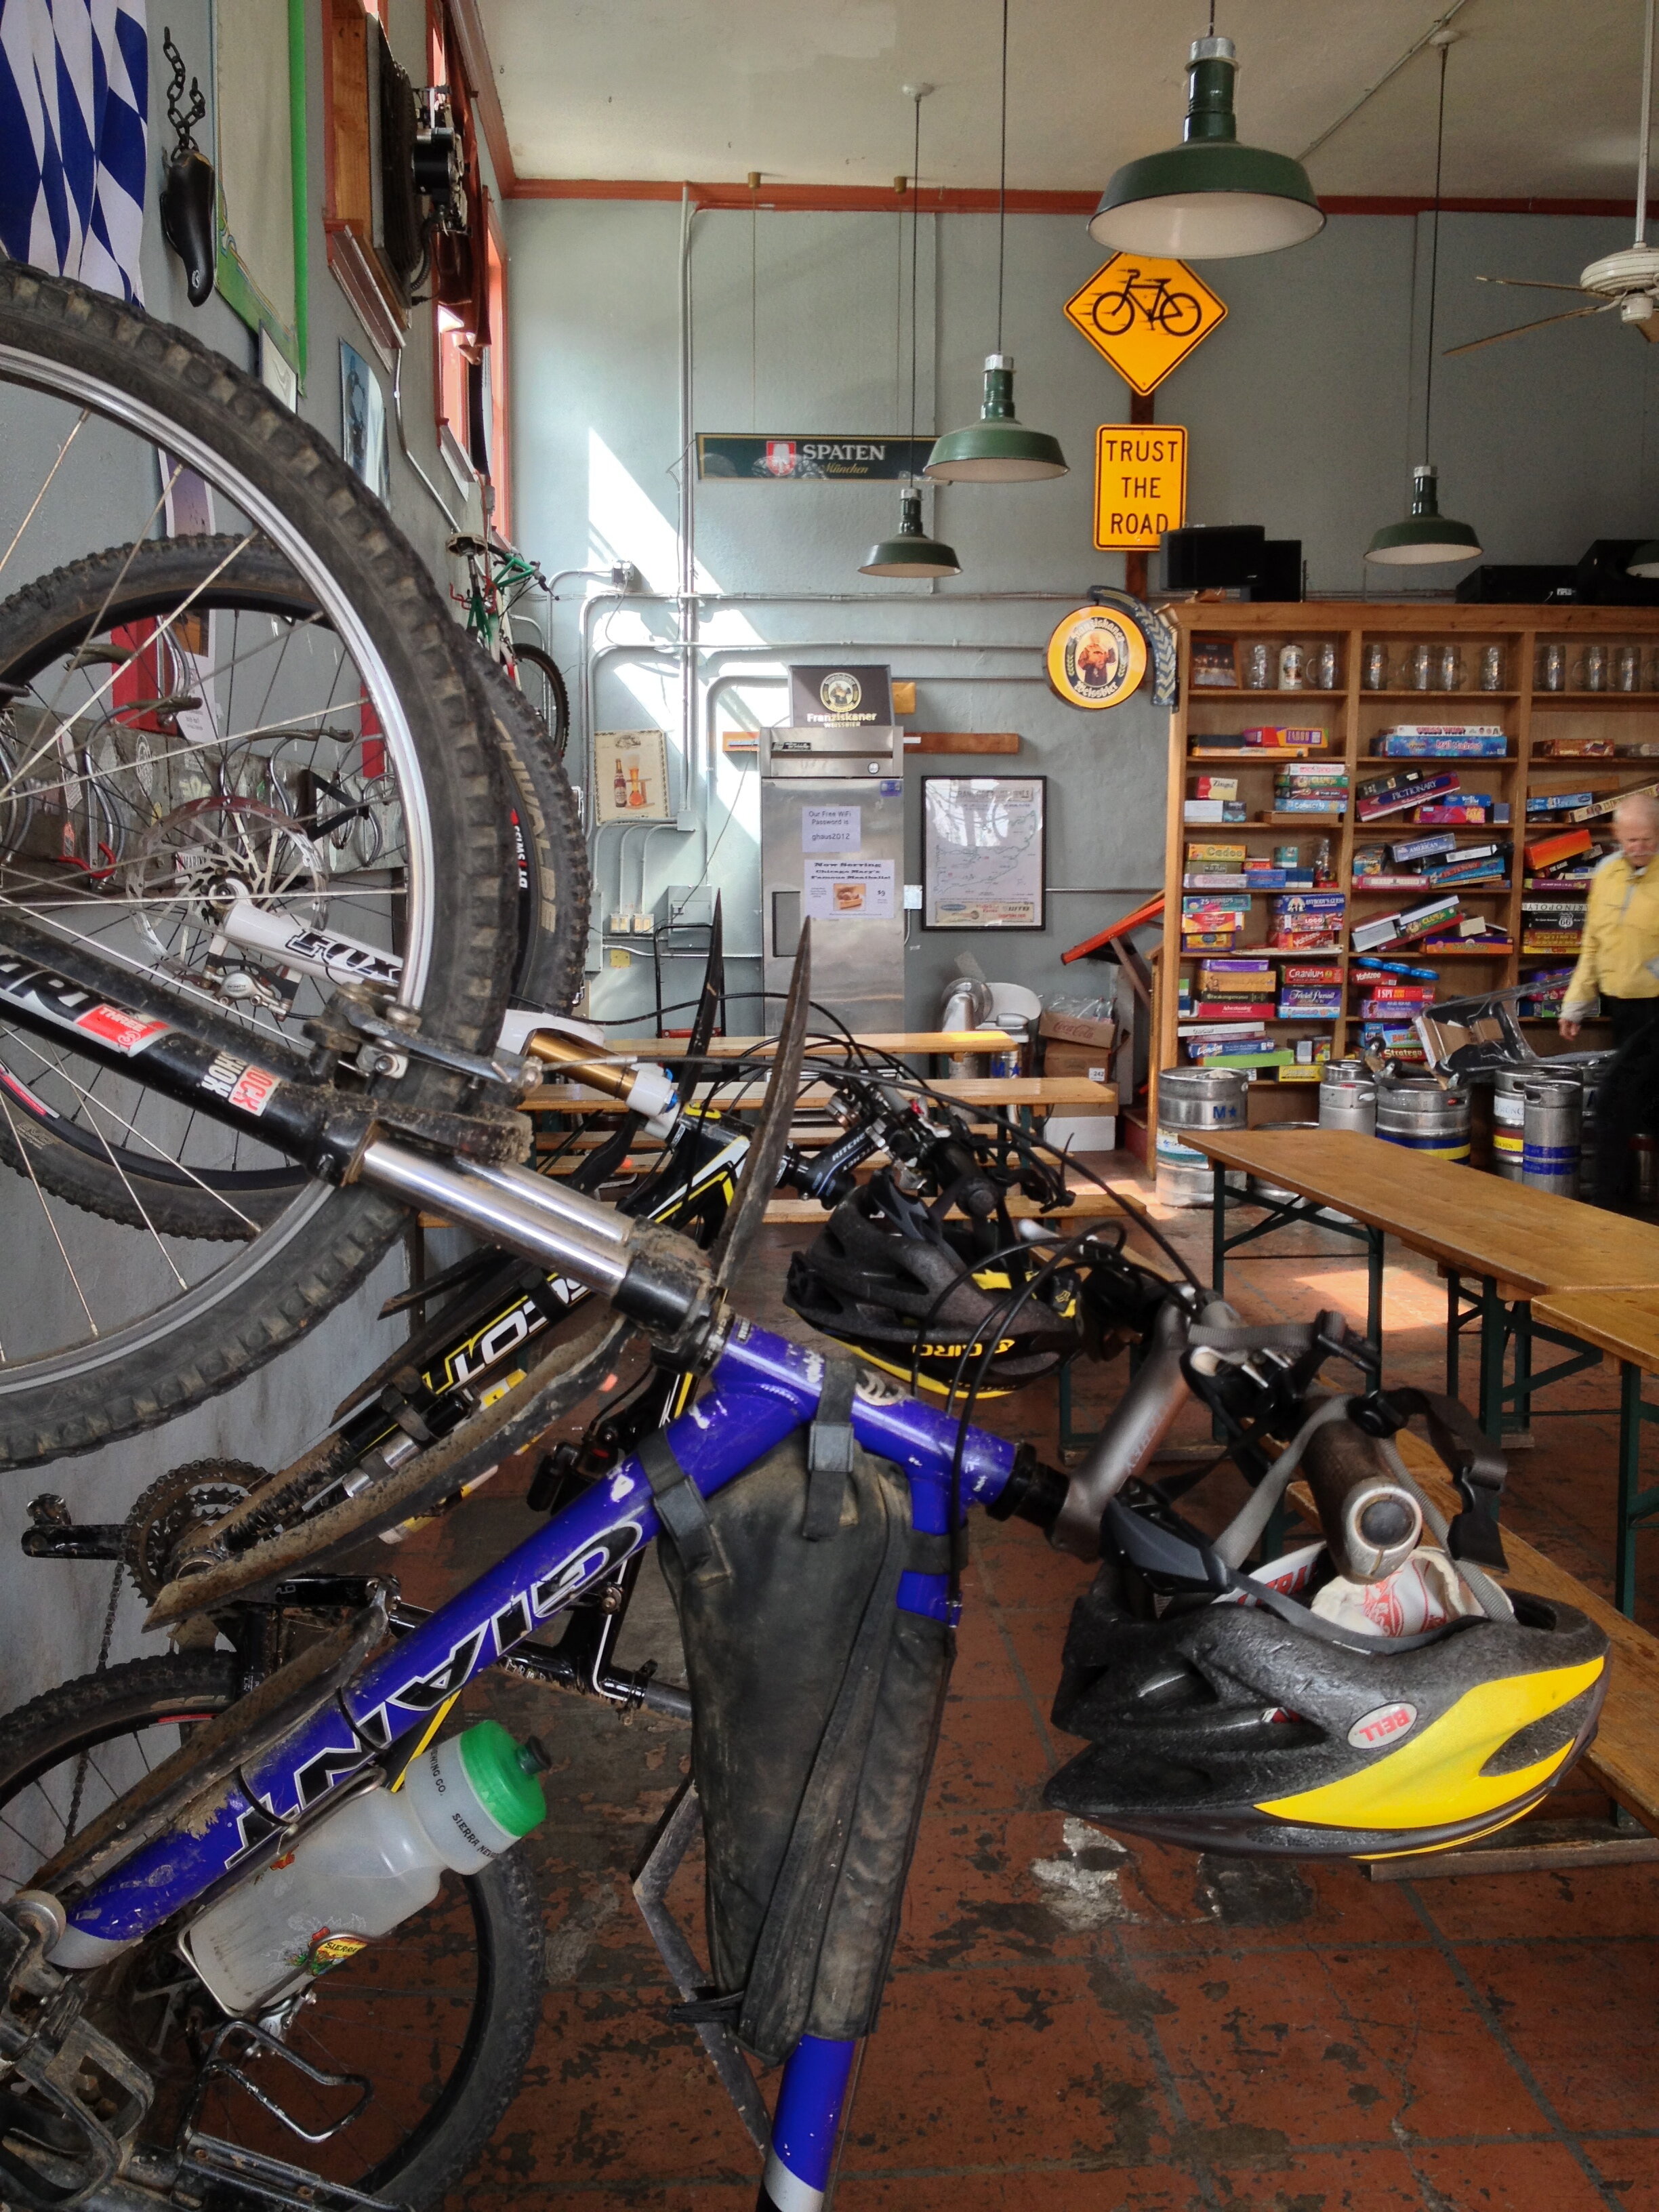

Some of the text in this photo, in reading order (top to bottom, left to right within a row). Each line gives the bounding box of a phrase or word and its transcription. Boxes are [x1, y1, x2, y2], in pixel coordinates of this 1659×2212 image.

[802, 444, 886, 461] SPATEN
[1106, 441, 1178, 462] TRUST
[1121, 477, 1161, 498] THE
[1111, 513, 1168, 535] ROAD
[807, 712, 877, 722] Franziskaner
[1393, 780, 1437, 800] PICTIONARY
[812, 833, 851, 841] ghaus2012
[1206, 846, 1243, 857] Cadoo
[1356, 972, 1381, 981] Yahtzee
[1382, 989, 1393, 998] SPY
[99, 1007, 147, 1033] THREE
[1384, 1049, 1422, 1059] Stratego
[1213, 1106, 1226, 1119] M
[832, 1132, 866, 1161] RITCHE
[912, 1343, 983, 1357] GIRO
[224, 1521, 644, 1870] GIANT
[1358, 1708, 1410, 1742] BELL
[435, 1778, 446, 1797] CO.
[452, 1813, 480, 1847] SIERRA
